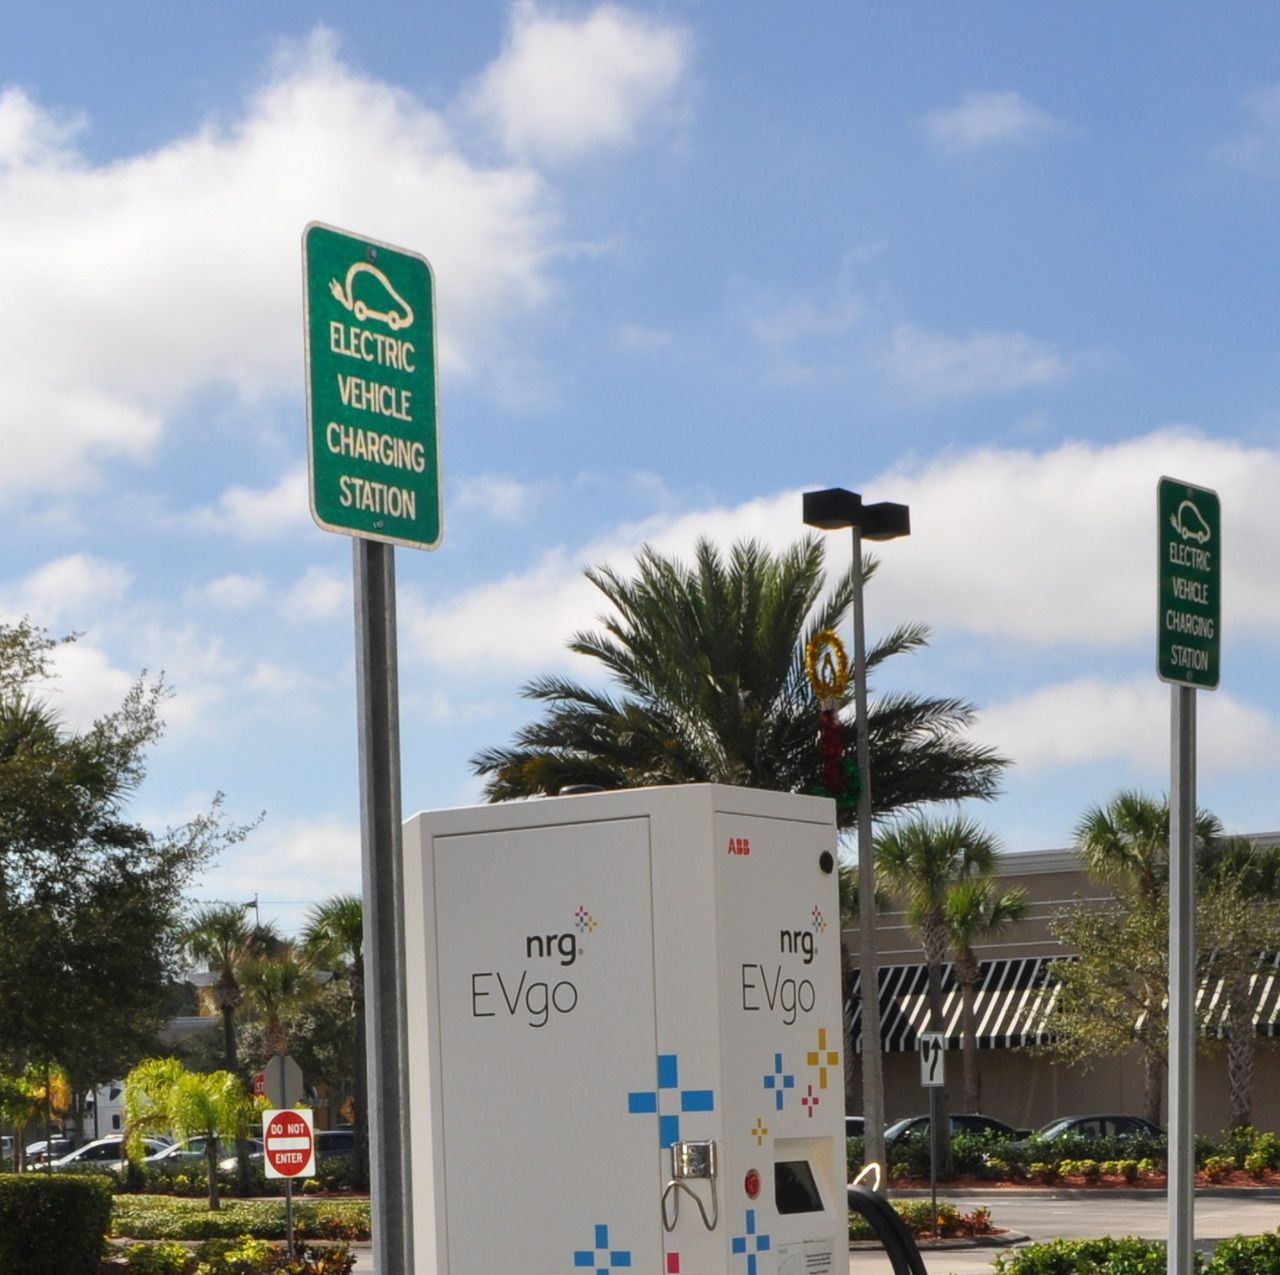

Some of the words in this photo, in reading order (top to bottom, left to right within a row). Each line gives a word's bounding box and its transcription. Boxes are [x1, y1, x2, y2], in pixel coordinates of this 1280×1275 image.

[330, 320, 415, 373] ELECTRIC
[337, 373, 413, 422] VEHICLE
[326, 421, 425, 473] CHARGING
[339, 475, 416, 521] STATION
[1169, 542, 1211, 572] ELECTRIC
[1172, 577, 1208, 605] VEHICLE
[1166, 609, 1214, 639] CHARGING
[1171, 644, 1208, 672] STATION
[728, 837, 750, 856] ABB
[526, 933, 577, 967] nrg
[780, 929, 814, 965] nrg
[472, 970, 578, 1028] EVgo
[741, 963, 816, 1026] EVgo
[271, 1124, 283, 1134] DO
[288, 1123, 305, 1134] NOT
[275, 1153, 303, 1164] ENTER
